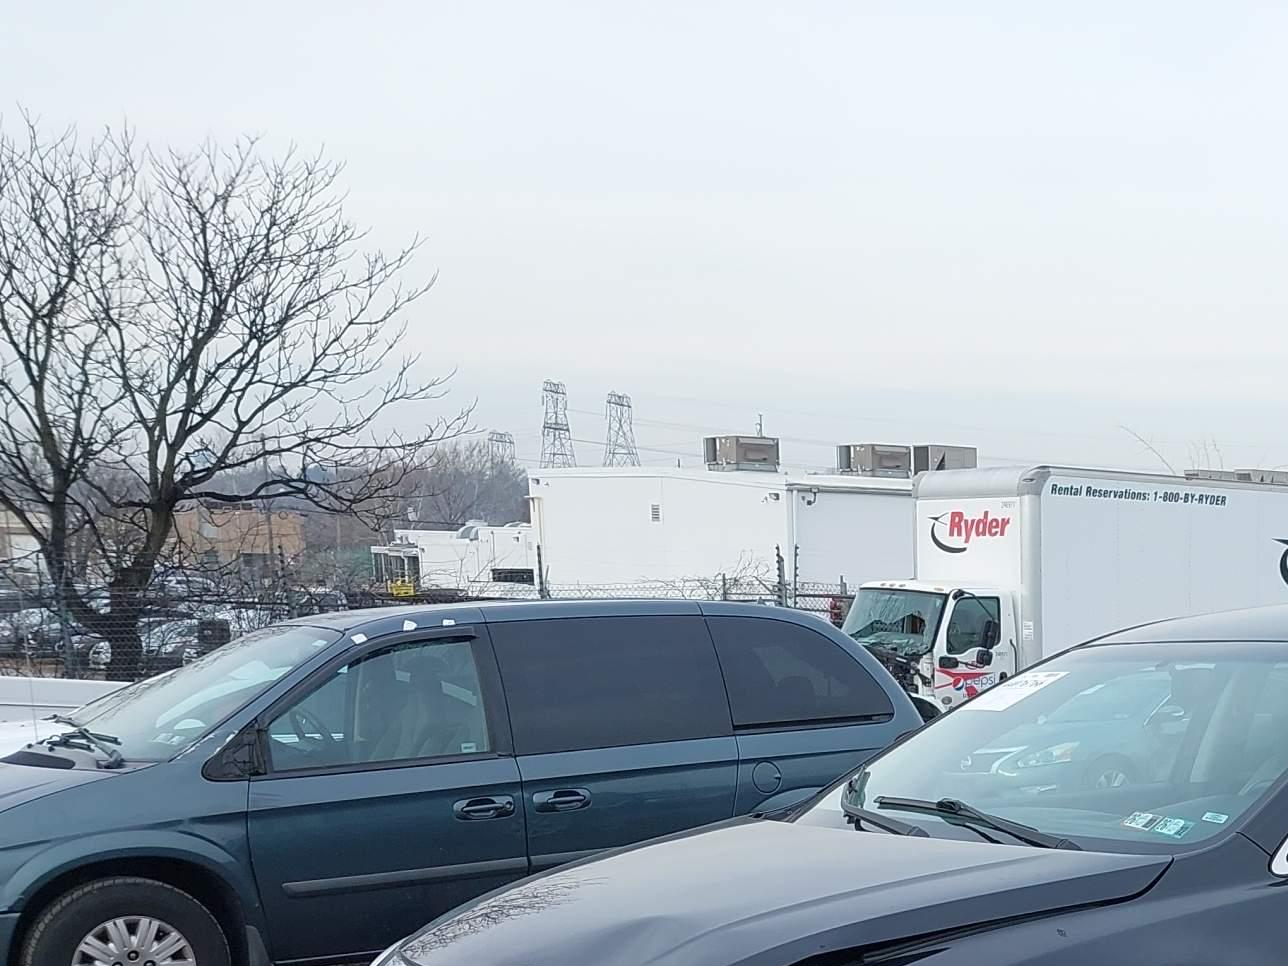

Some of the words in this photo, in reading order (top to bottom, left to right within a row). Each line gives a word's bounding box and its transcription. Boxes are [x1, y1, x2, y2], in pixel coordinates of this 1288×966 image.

[1050, 483, 1083, 497] Rental
[1085, 486, 1150, 501] Reservations:
[1153, 491, 1227, 507] 1-800-BY-RYDER
[948, 510, 1010, 544] Ryder
